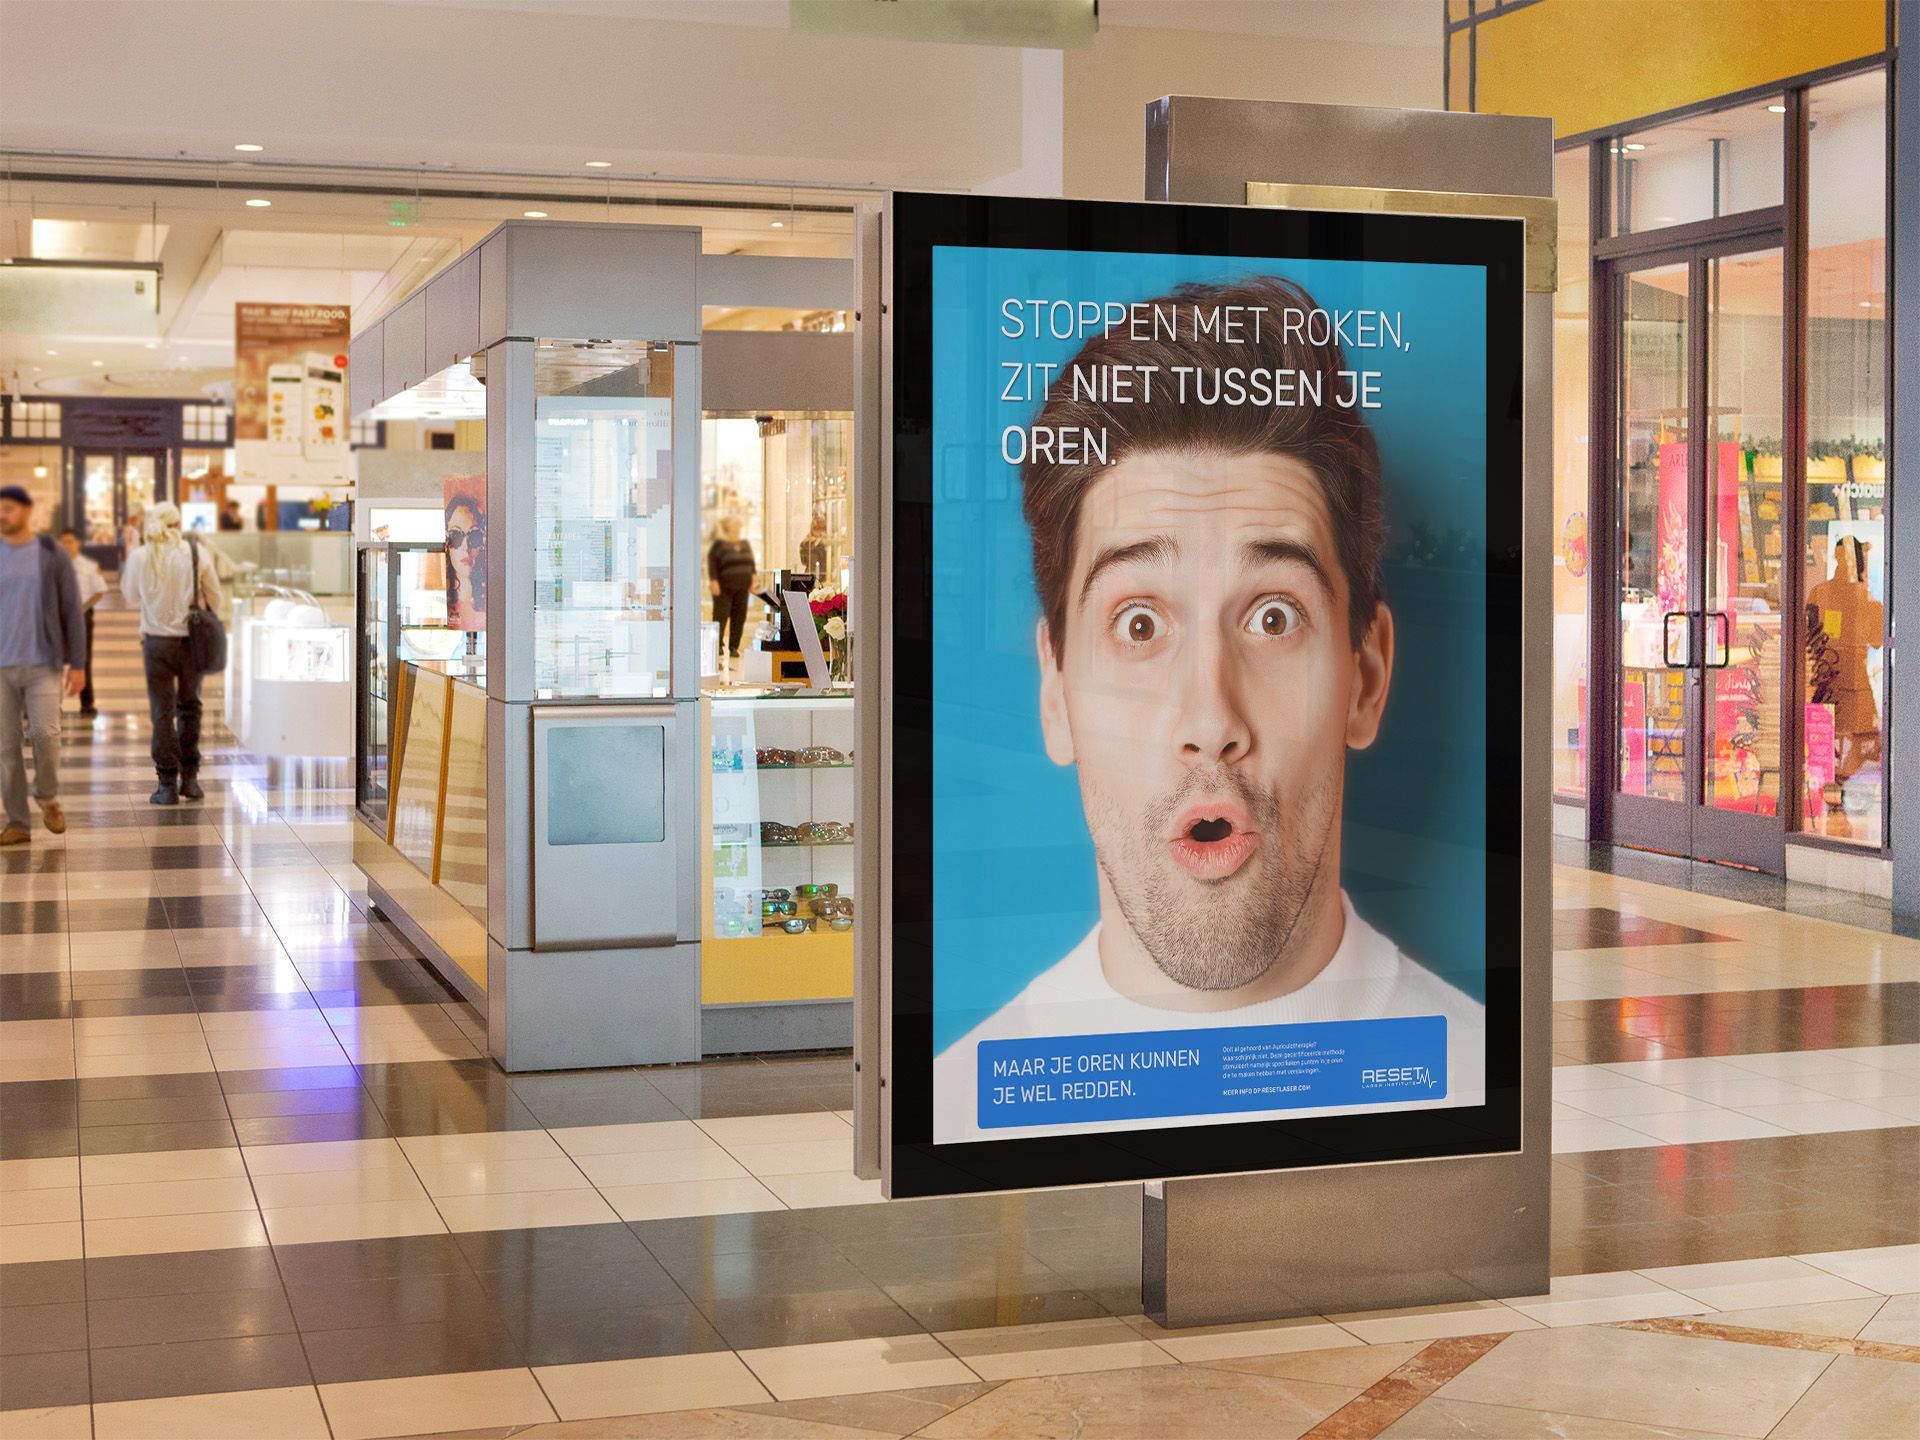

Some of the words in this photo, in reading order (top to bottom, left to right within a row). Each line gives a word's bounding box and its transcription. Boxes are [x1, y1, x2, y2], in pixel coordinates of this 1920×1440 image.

[1000, 298, 1177, 342] STOPPEN
[1193, 305, 1269, 344] MET
[1283, 307, 1411, 352] ROKEN,
[1001, 362, 1058, 401] ZIT
[1073, 364, 1158, 404] NIET
[1171, 366, 1323, 407] TUSSEN
[1336, 370, 1383, 409] JE
[1001, 425, 1117, 466] OREN.
[993, 1058, 1045, 1077] MAAR
[1050, 1056, 1073, 1074] JE
[1077, 1053, 1124, 1073] OREN
[1130, 1049, 1200, 1069] KUNNEN
[1362, 1066, 1424, 1083] RESET
[993, 1087, 1016, 1105] JE
[1021, 1084, 1056, 1102] WEL
[1062, 1080, 1136, 1100] REDDEN.
[1223, 1088, 1239, 1097] MEER
[1239, 1087, 1253, 1095] INFO
[1253, 1087, 1261, 1095] OP
[1261, 1084, 1312, 1094] RESETLASER.COM
